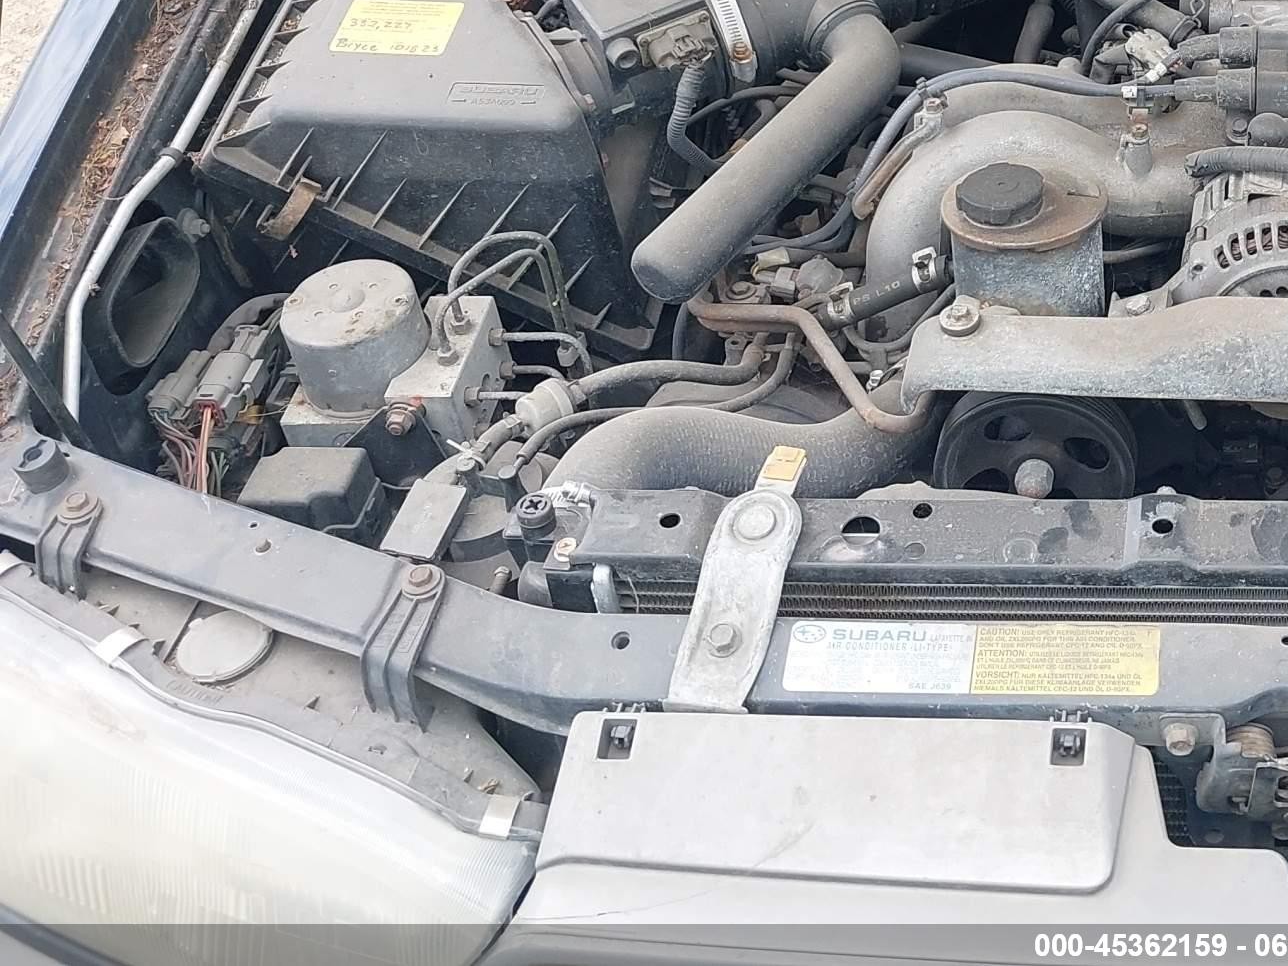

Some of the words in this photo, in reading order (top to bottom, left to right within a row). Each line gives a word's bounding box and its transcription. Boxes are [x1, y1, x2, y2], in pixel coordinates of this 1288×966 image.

[832, 628, 928, 642] SUBARU
[826, 641, 842, 650] AIR
[845, 641, 907, 651] CONDITIONER
